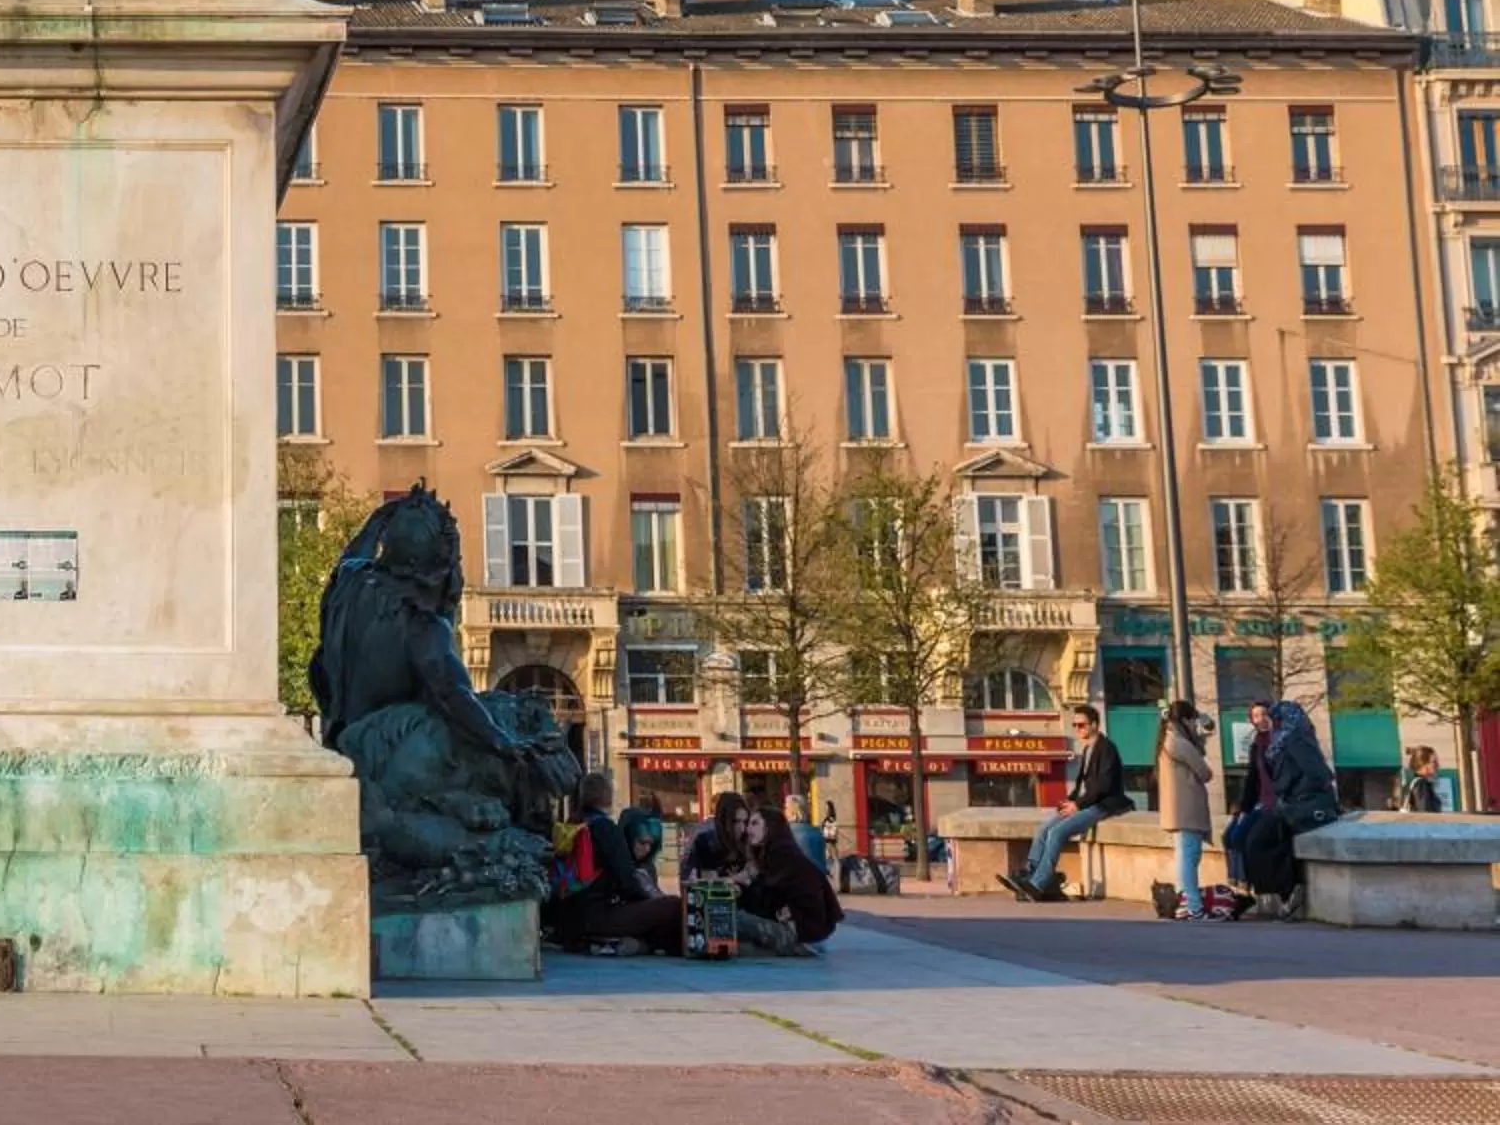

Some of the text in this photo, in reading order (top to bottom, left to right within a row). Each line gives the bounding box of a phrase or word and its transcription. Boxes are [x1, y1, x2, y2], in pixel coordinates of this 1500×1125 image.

[861, 738, 909, 748] PIGNO
[985, 738, 1045, 750] PIGNOL
[643, 756, 707, 770] PIGNOL
[739, 759, 792, 771] TRAITEU
[883, 759, 949, 772] PIGOL
